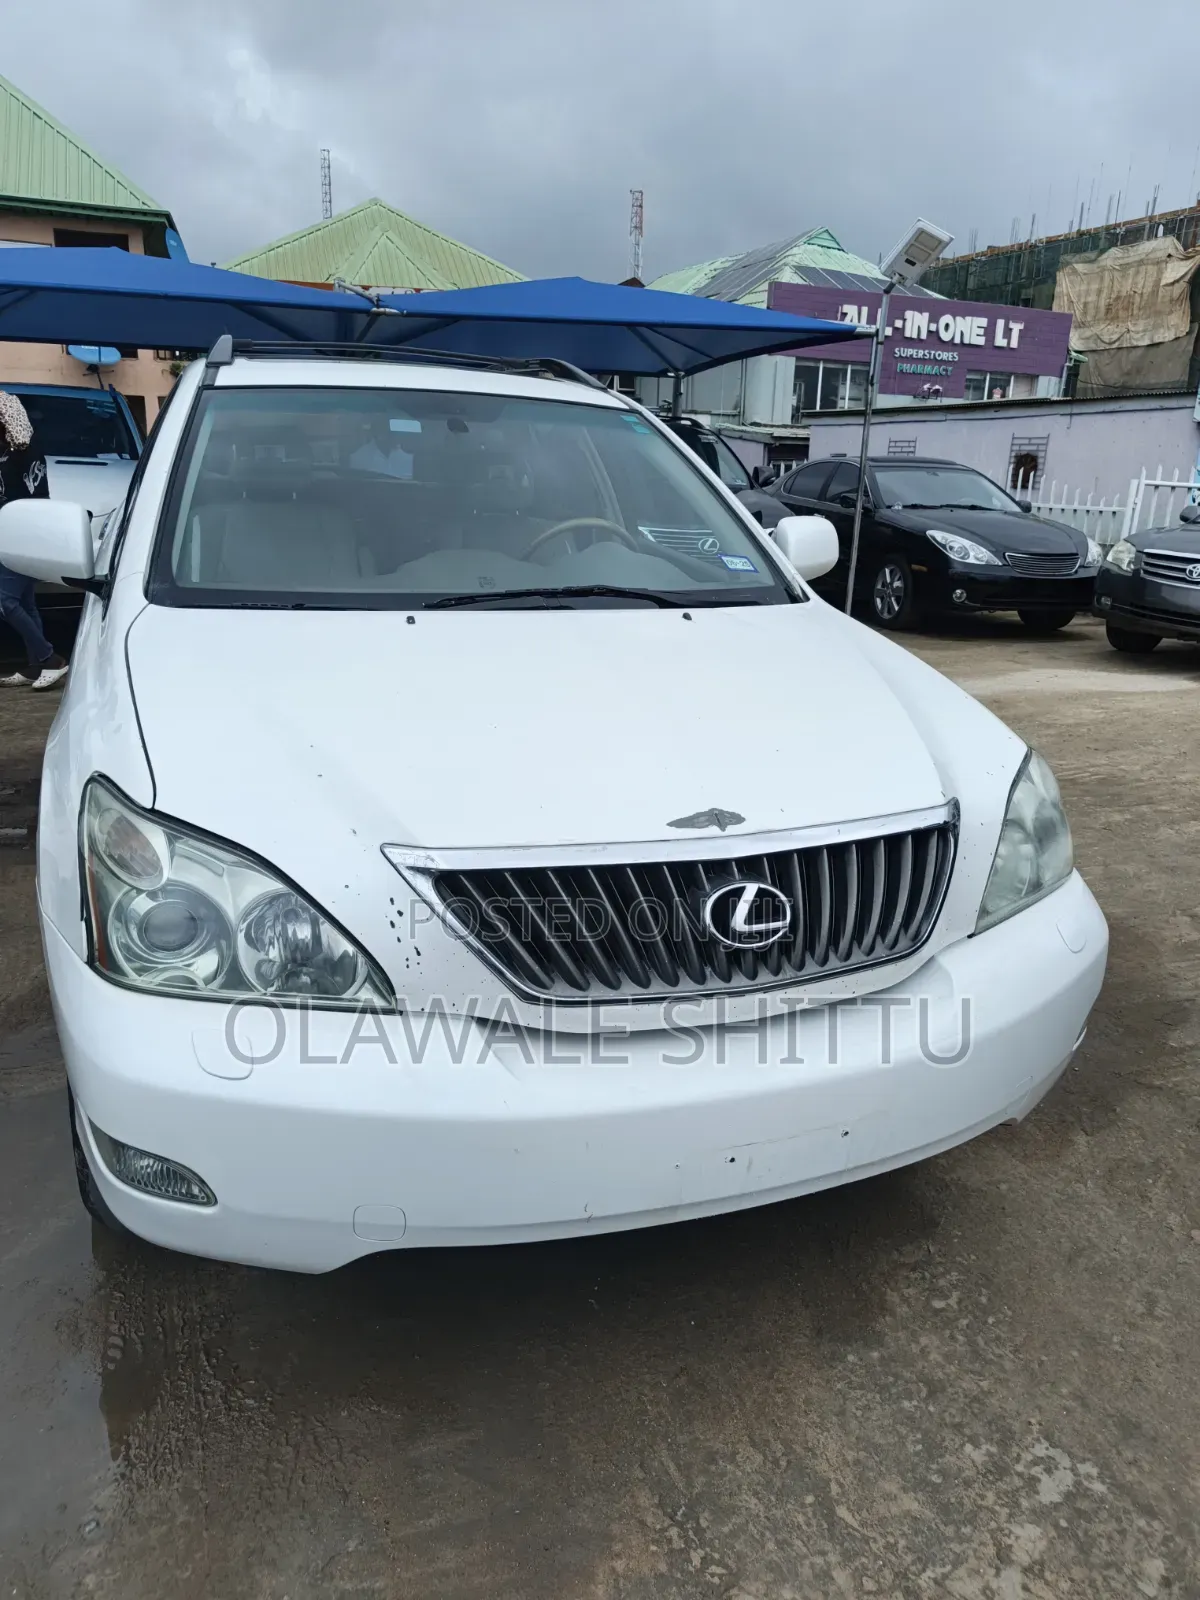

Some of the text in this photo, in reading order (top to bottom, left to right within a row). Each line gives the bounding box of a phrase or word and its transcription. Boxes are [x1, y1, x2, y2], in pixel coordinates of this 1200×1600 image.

[994, 318, 1025, 349] LT
[894, 347, 959, 361] SUPERSTORES
[897, 363, 953, 376] PHARMACY
